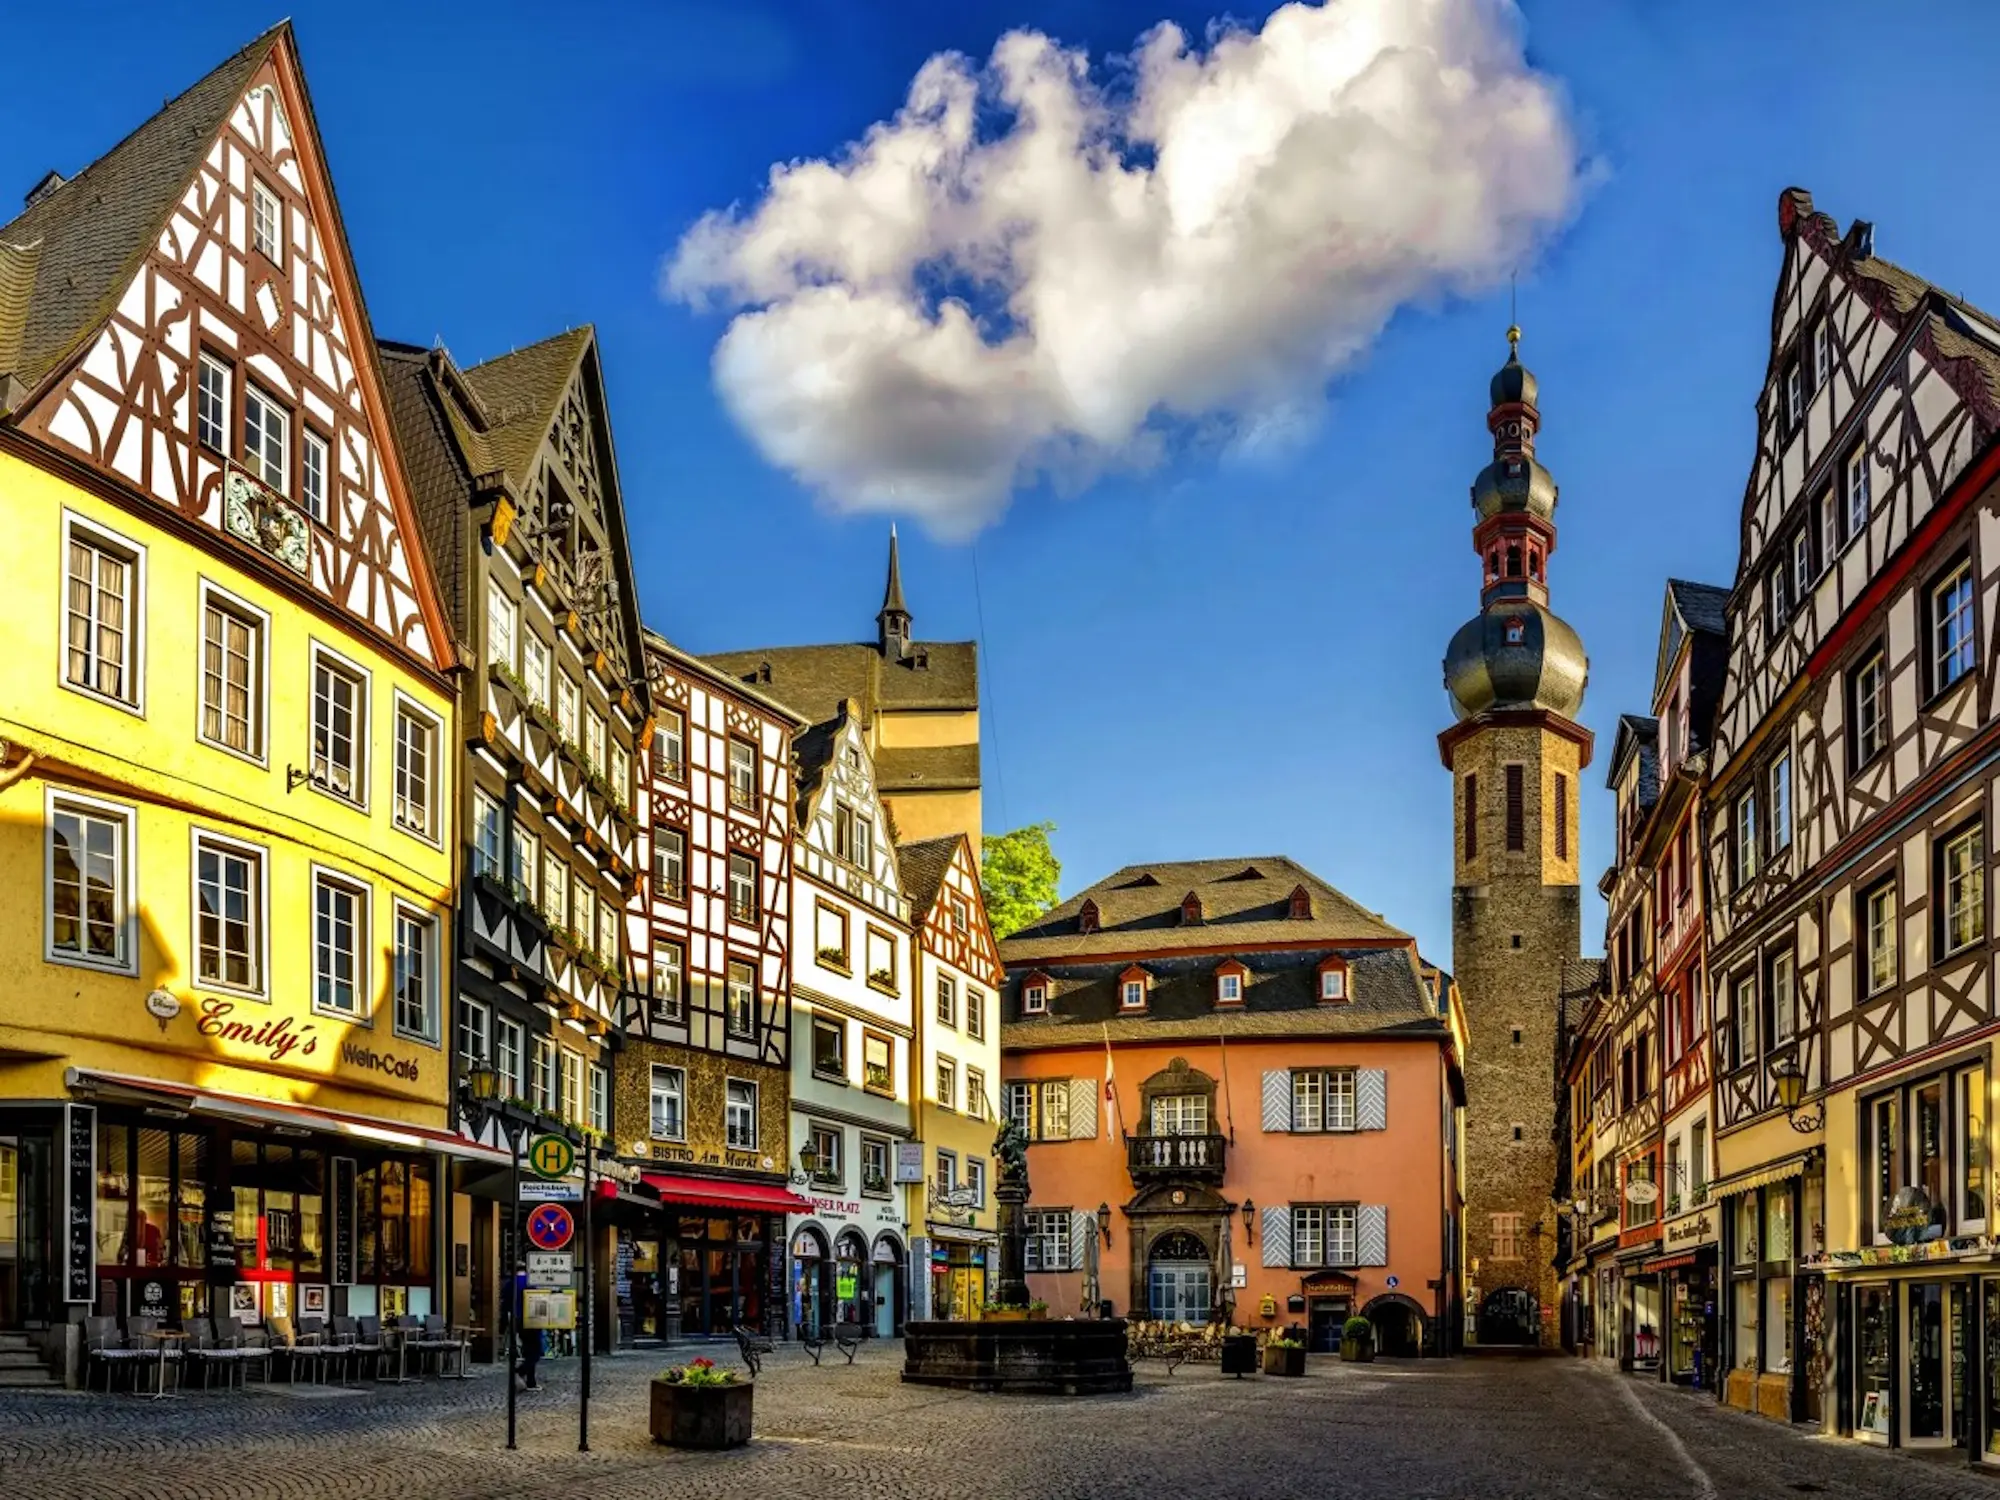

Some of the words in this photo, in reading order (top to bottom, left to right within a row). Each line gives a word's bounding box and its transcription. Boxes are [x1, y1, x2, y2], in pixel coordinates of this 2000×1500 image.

[341, 1041, 419, 1081] Wein-Café
[543, 1145, 560, 1168] H
[653, 1146, 694, 1162] BISTRO
[699, 1151, 719, 1164] Am
[723, 1151, 758, 1169] Markt
[522, 1184, 571, 1192] Reichsburg
[836, 1201, 860, 1214] PLATZ
